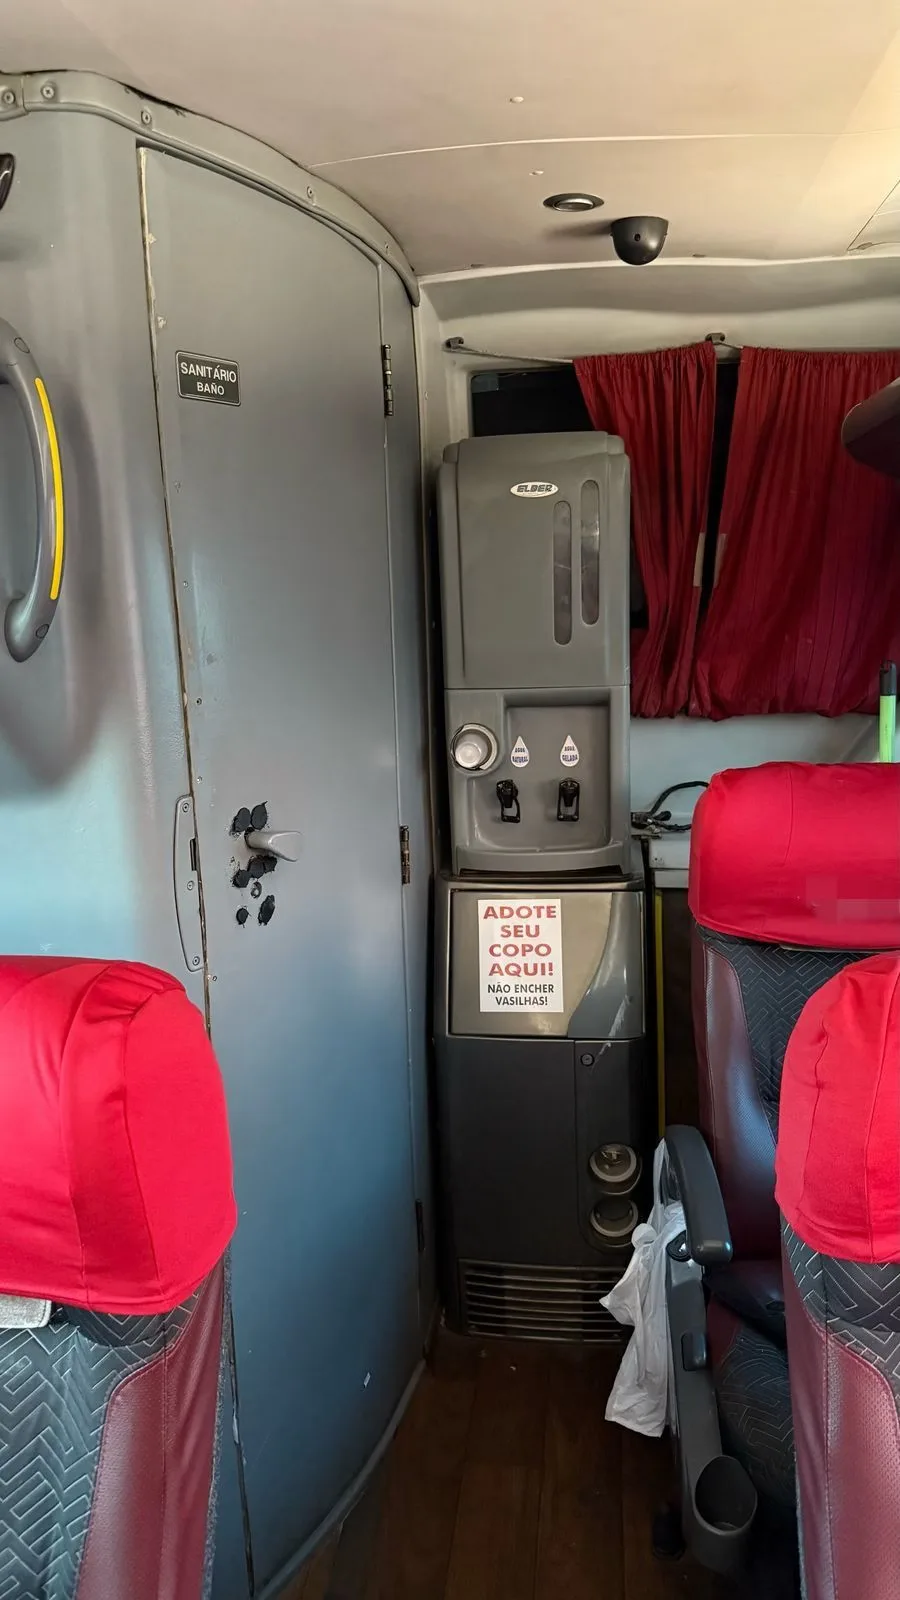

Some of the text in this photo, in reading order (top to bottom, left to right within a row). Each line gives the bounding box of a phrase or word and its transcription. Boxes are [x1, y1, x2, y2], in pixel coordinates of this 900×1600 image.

[180, 362, 237, 383] SANITÁRIO
[196, 382, 225, 396] BAÑO
[516, 484, 553, 493] ELBER
[512, 755, 528, 763] NATURAL
[483, 905, 557, 919] ADOTE
[500, 924, 540, 938] SEU
[488, 943, 552, 957] COPO
[488, 962, 554, 977] AQUI!
[487, 981, 554, 993] NÃO ENCHER
[495, 996, 548, 1006] VASILHAS!
